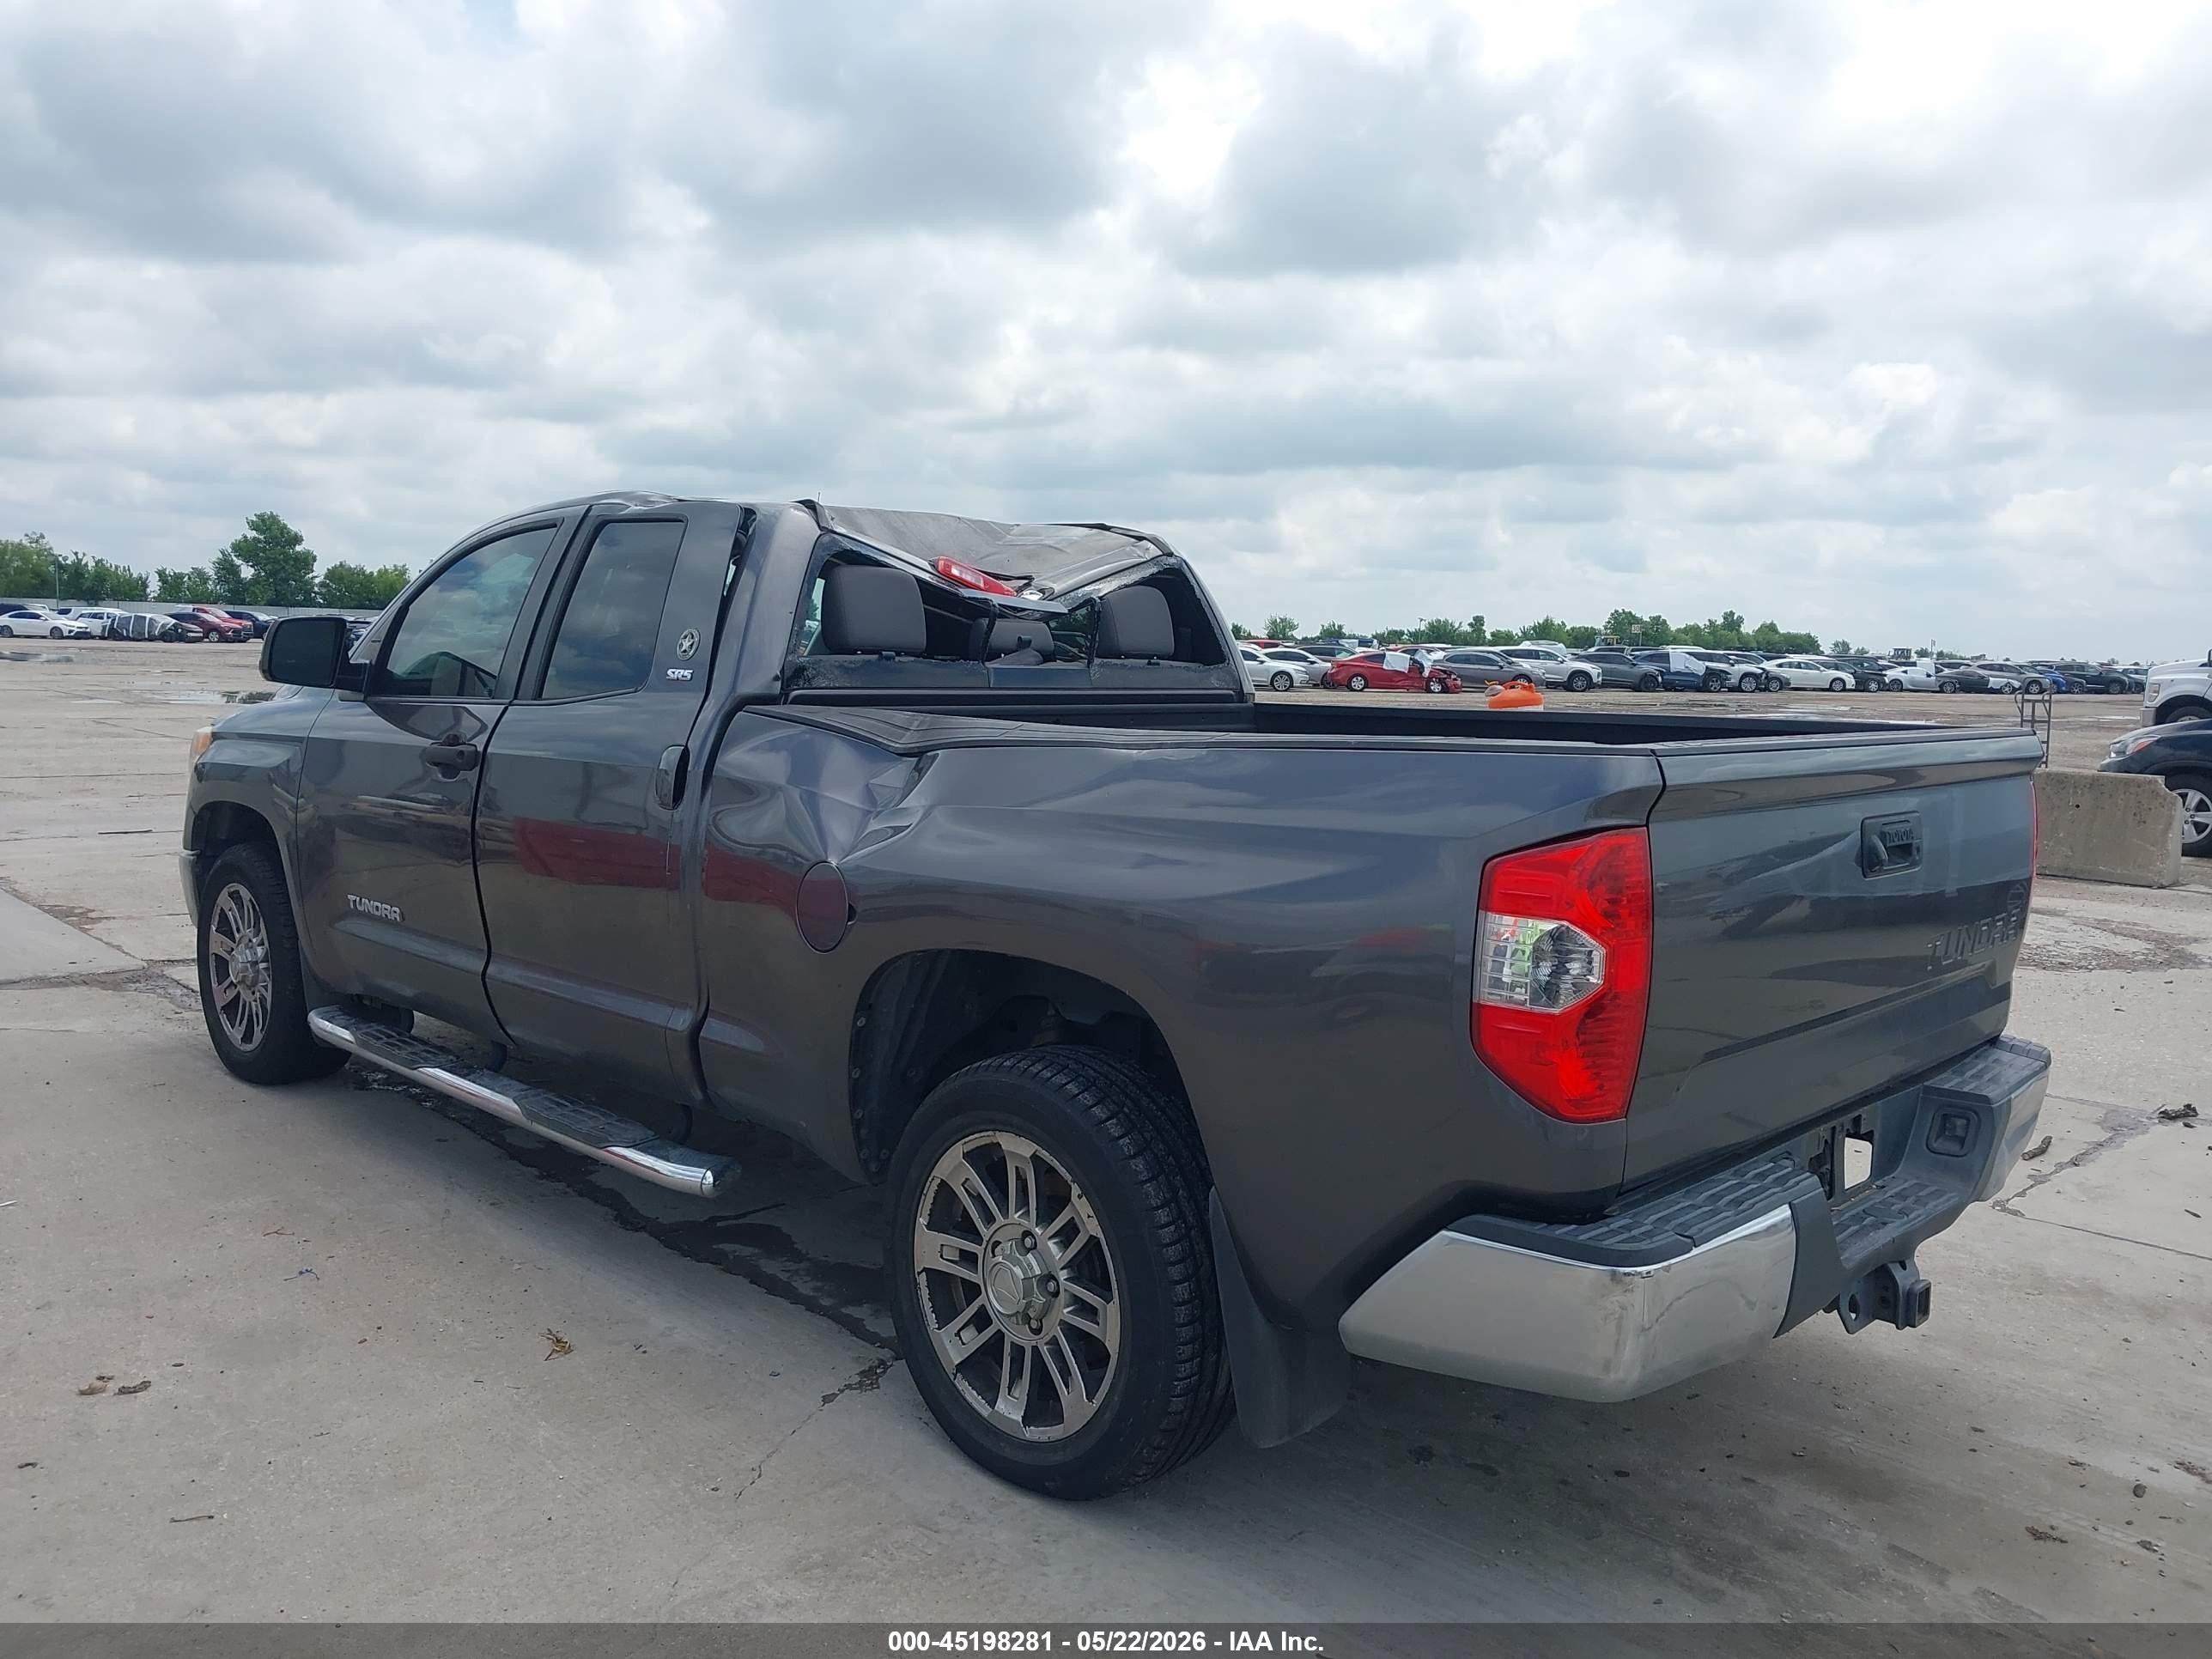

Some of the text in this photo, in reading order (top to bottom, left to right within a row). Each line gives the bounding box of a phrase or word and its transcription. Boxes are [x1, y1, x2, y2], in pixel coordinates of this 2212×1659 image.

[665, 668, 693, 681] SR5
[346, 894, 401, 922] TUNDRA
[1926, 908, 2021, 970] TUNDRA
